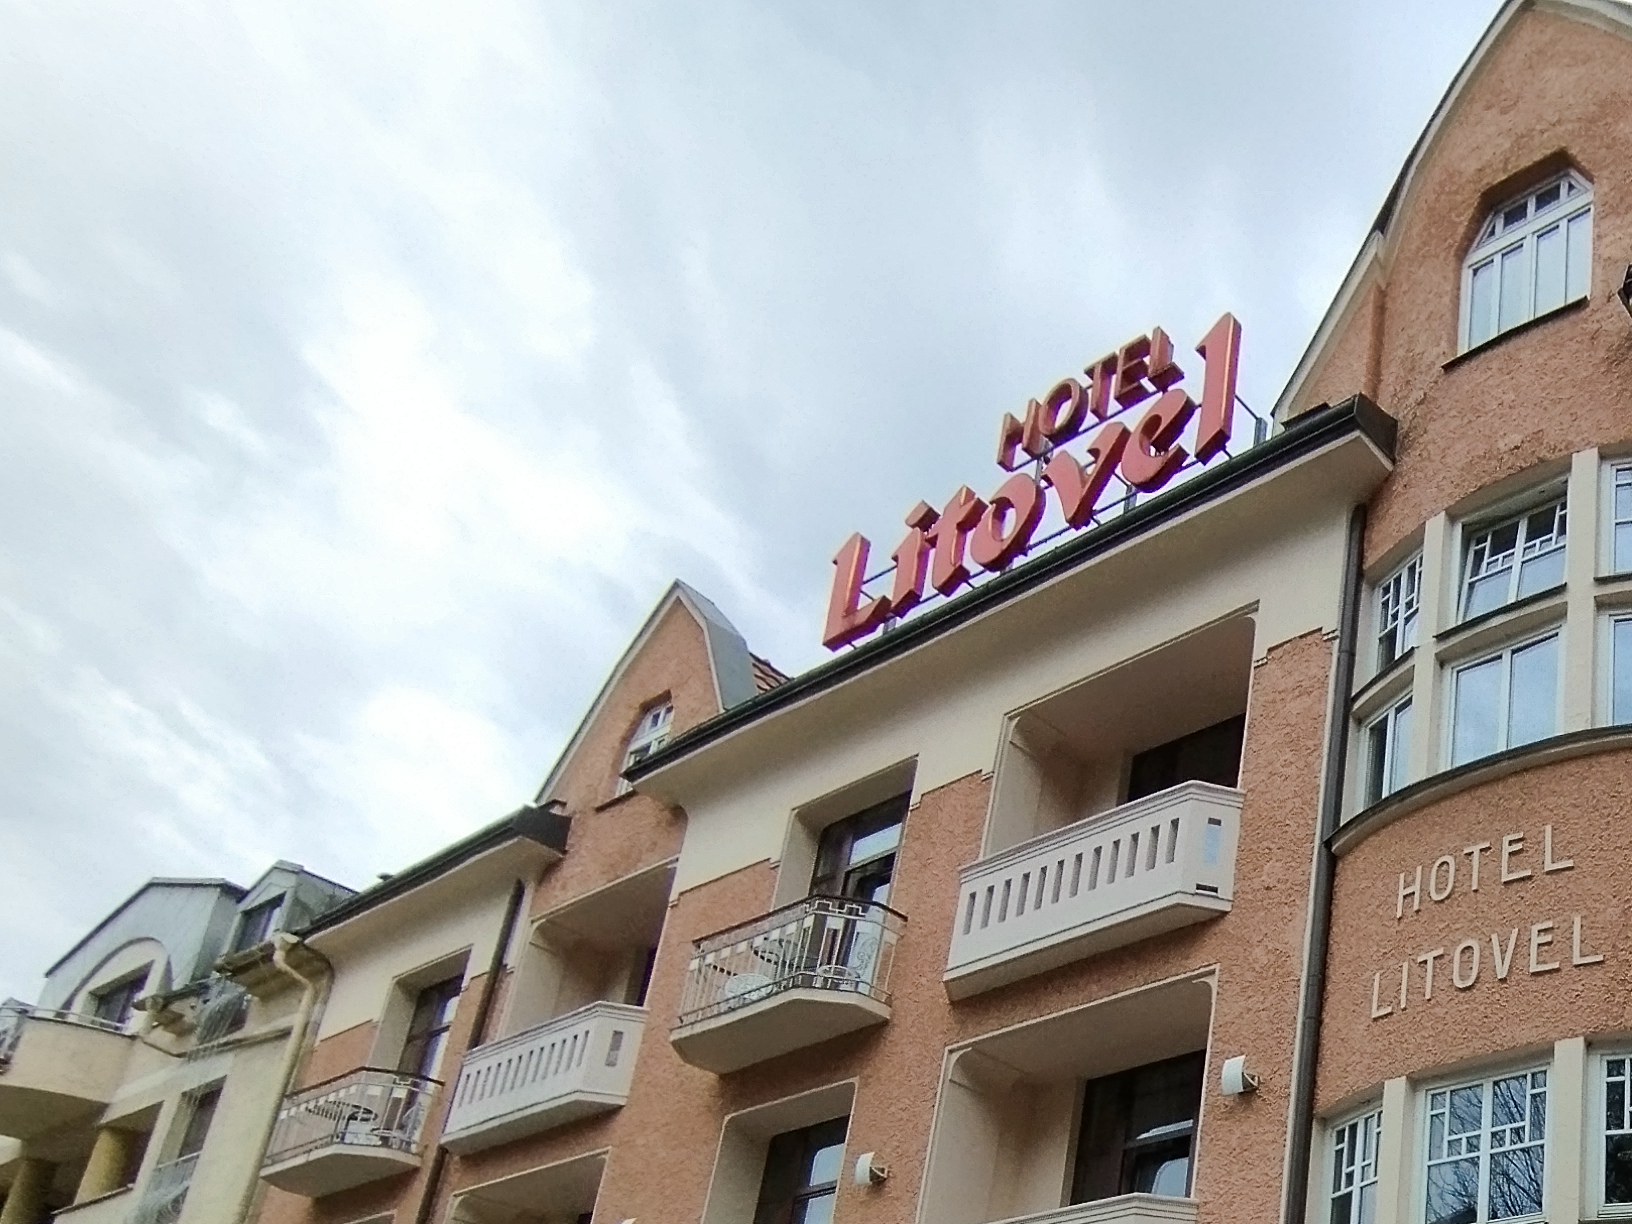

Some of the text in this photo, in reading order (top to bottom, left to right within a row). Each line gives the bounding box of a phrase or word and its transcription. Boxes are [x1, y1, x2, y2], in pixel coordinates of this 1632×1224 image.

[997, 326, 1185, 472] HOTEL
[822, 311, 1242, 652] Litovel
[1397, 824, 1574, 919] HOTEL
[1371, 914, 1604, 1019] LITOVEL
